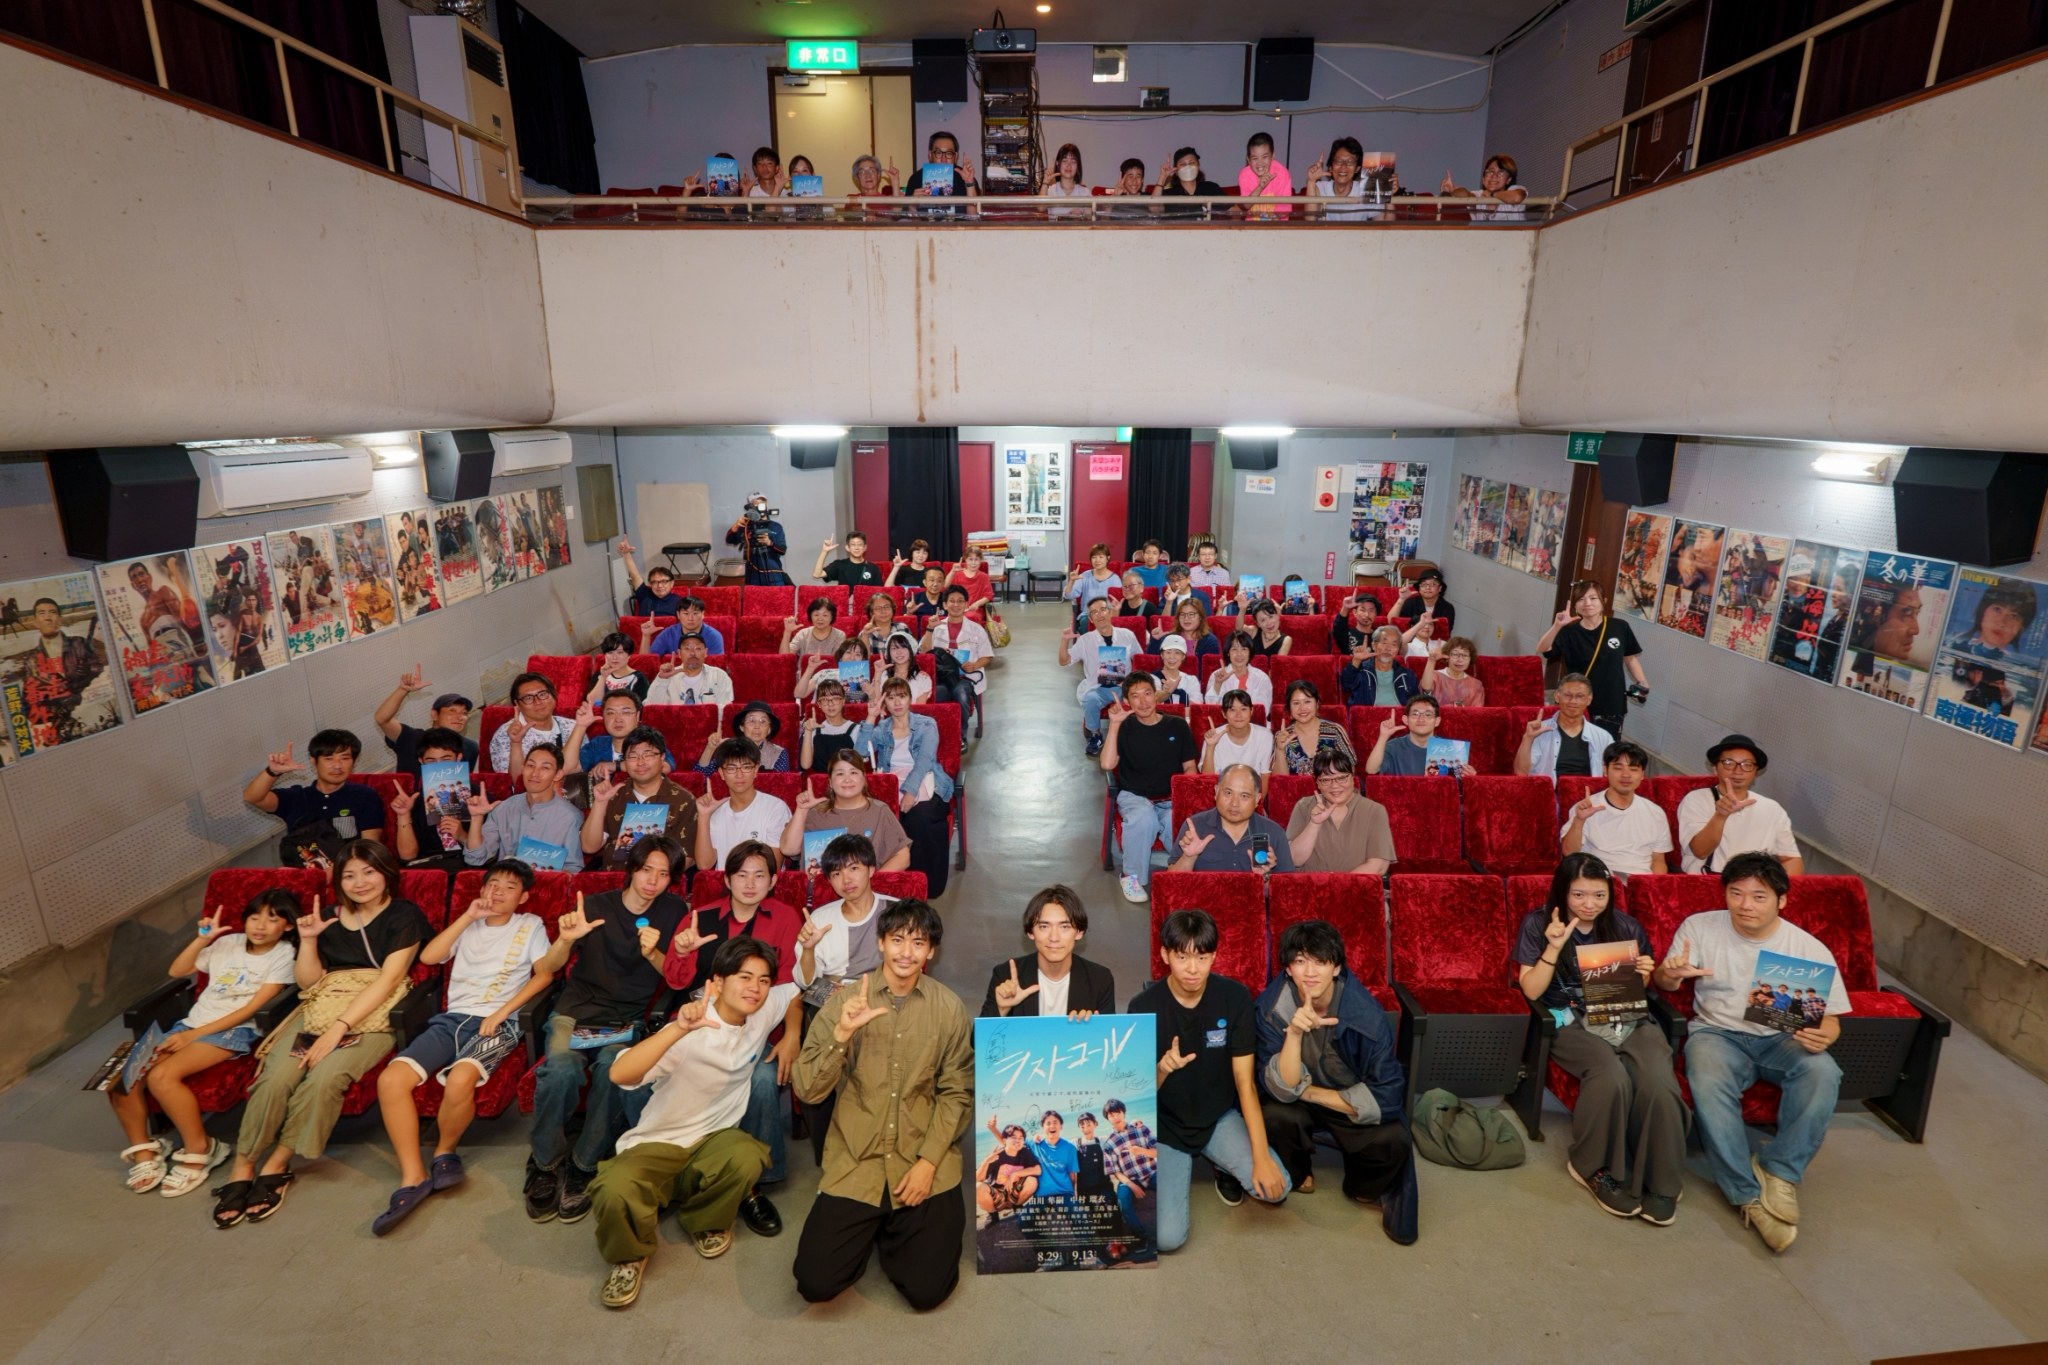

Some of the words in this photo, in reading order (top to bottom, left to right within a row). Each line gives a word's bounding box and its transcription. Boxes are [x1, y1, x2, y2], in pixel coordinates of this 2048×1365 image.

[798, 47, 847, 64] 非常口
[1574, 438, 1602, 456] 非常
[1878, 556, 1930, 590] 冬の華
[1935, 697, 2018, 746] 南極物語
[428, 765, 463, 783] ラストコール
[628, 806, 662, 822] ラストコール
[522, 845, 562, 860] ラストコール
[1583, 960, 1620, 982] ラストコール
[1763, 963, 1828, 978] ラストコール
[993, 1021, 1138, 1096] ラストコール
[1037, 1251, 1059, 1262] 8.29
[1072, 1250, 1093, 1261] 9.13
